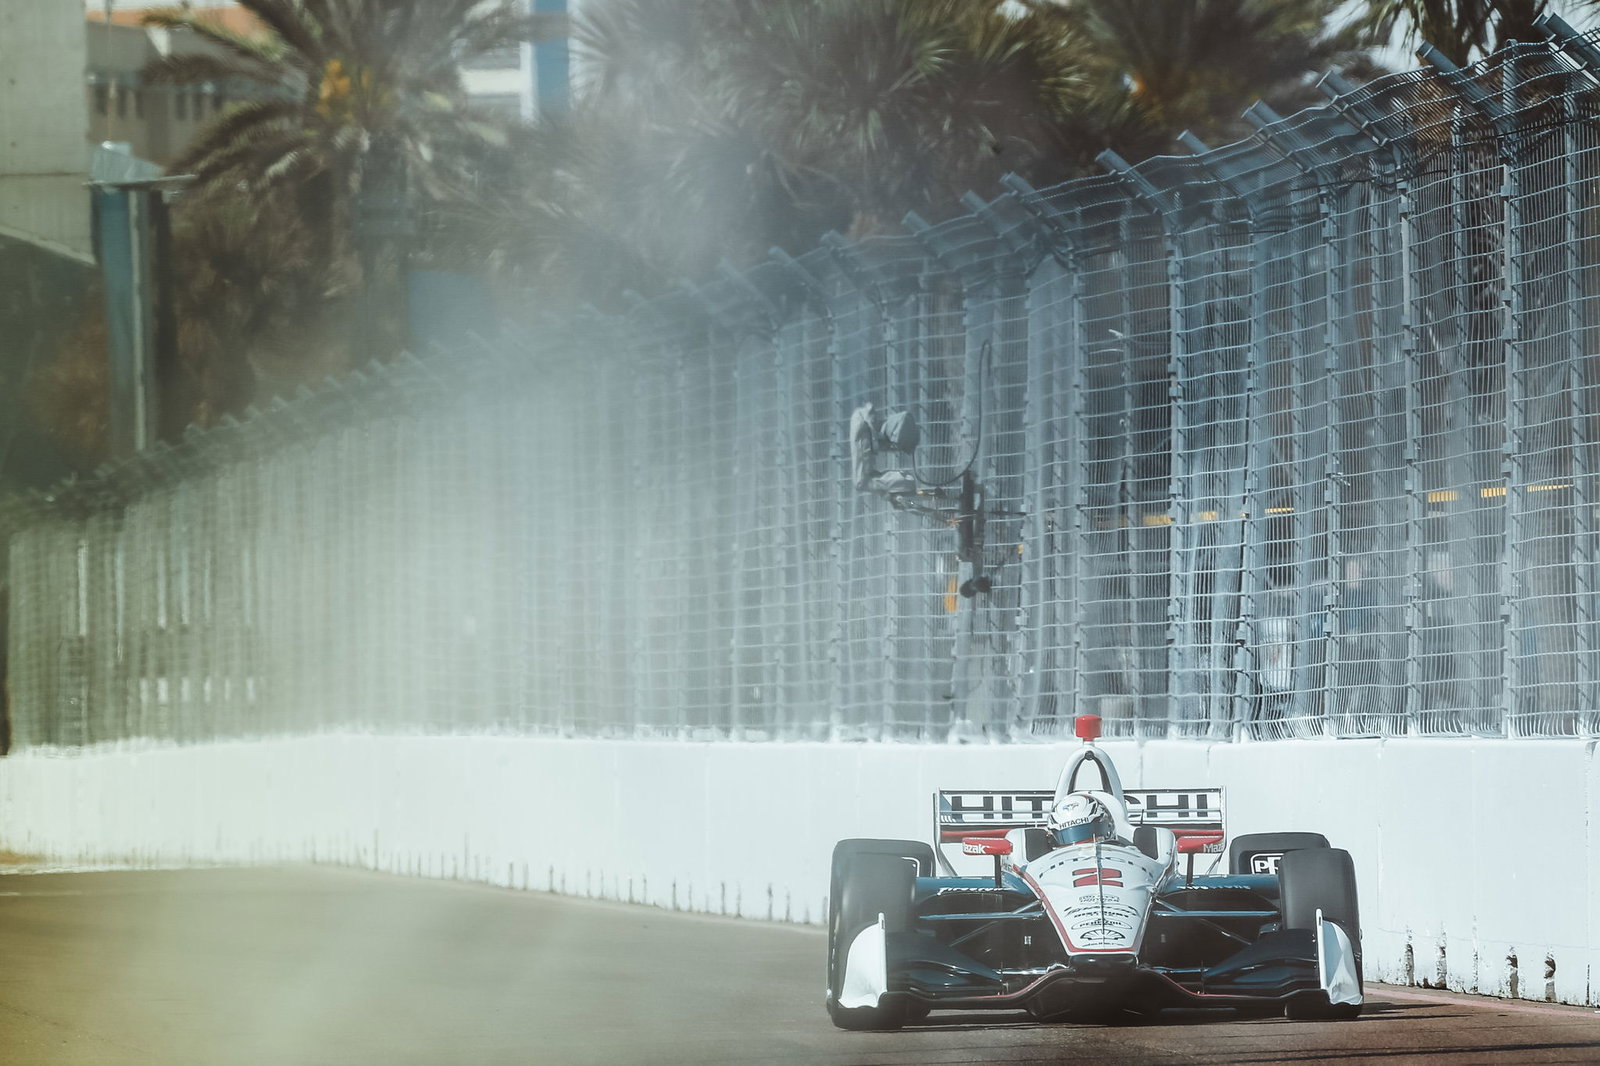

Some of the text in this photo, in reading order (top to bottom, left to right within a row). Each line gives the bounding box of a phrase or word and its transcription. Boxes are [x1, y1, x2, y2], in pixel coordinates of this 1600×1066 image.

[951, 794, 1208, 819] HITHI
[1059, 817, 1090, 829] HITACHI
[963, 841, 988, 854] azak
[1072, 868, 1124, 888] 2
